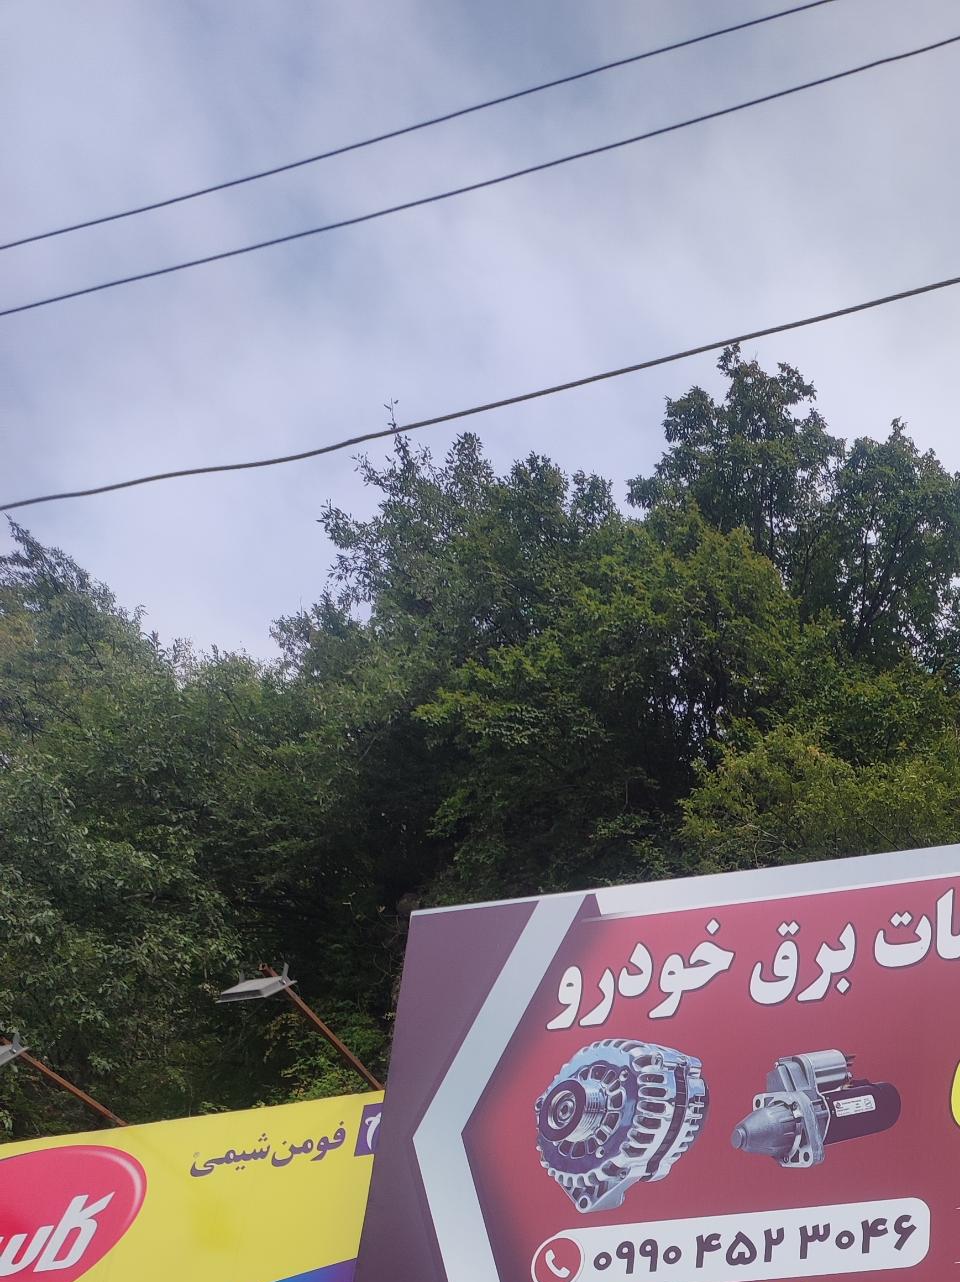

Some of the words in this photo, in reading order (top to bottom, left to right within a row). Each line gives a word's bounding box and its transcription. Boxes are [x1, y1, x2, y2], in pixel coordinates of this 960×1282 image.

[546, 917, 736, 1031] خودرو
[748, 922, 859, 1005] برق
[189, 1132, 272, 1178] شیمی
[271, 1120, 347, 1168] فومن
[0, 1190, 116, 1278] کاس
